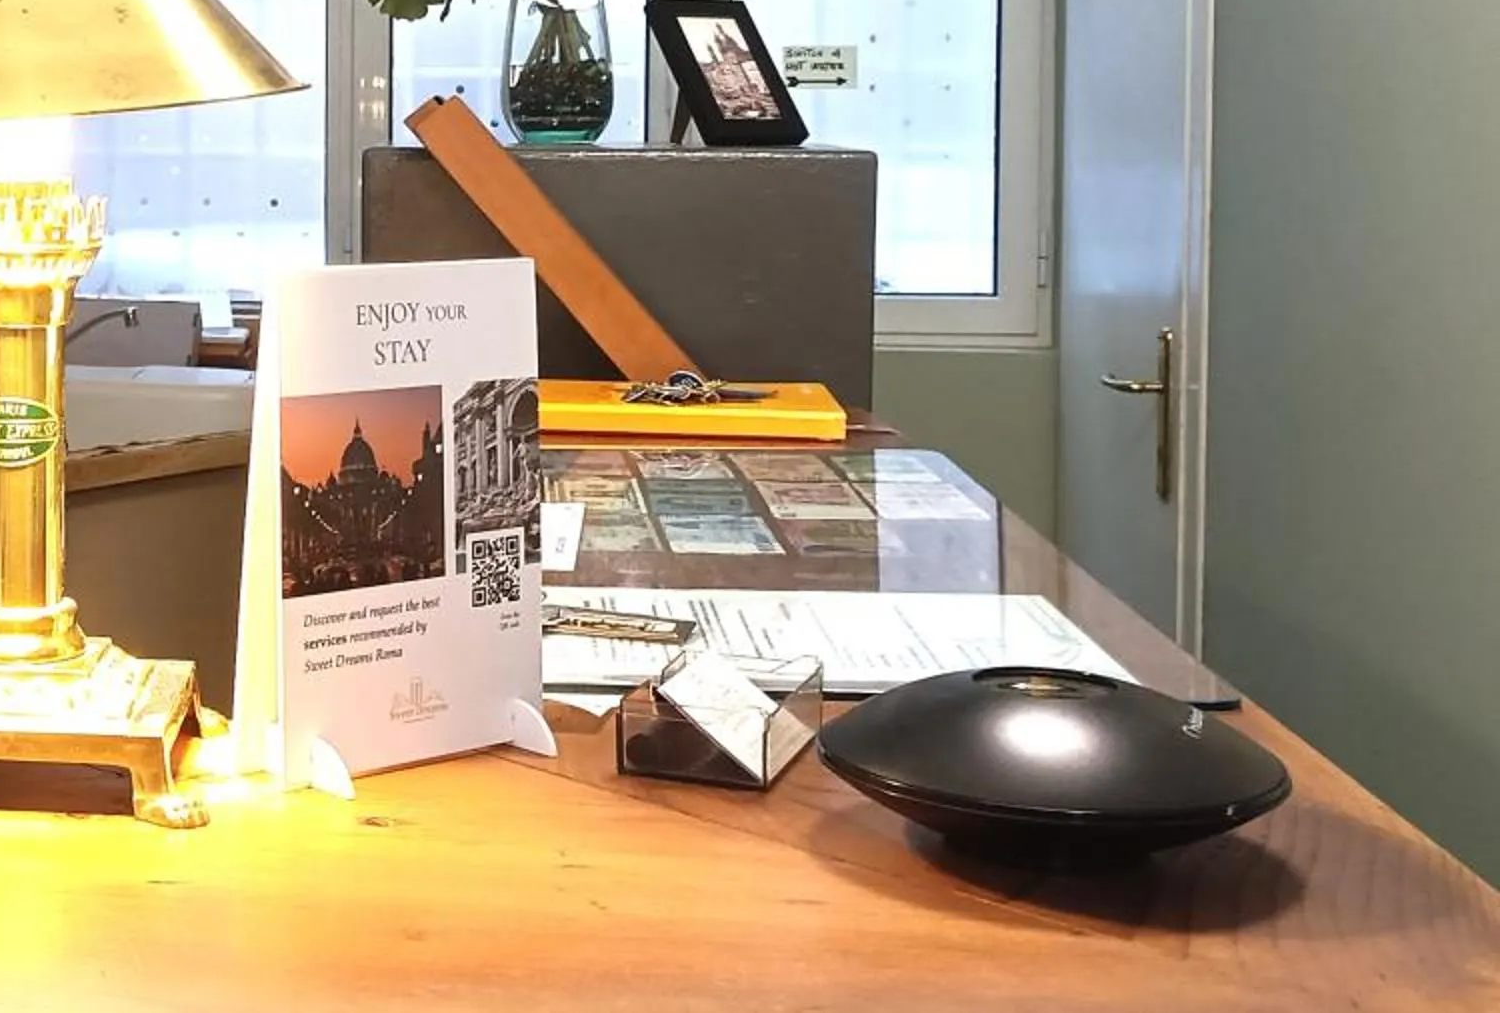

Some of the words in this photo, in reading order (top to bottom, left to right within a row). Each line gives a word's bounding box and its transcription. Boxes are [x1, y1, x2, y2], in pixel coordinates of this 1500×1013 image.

[356, 302, 420, 331] ENJOY
[426, 303, 467, 323] YOUR
[374, 338, 432, 366] STAY
[349, 606, 367, 621] and
[303, 634, 347, 650] services
[415, 620, 428, 636] by
[304, 658, 333, 673] Sweet
[335, 652, 373, 668] Dreams
